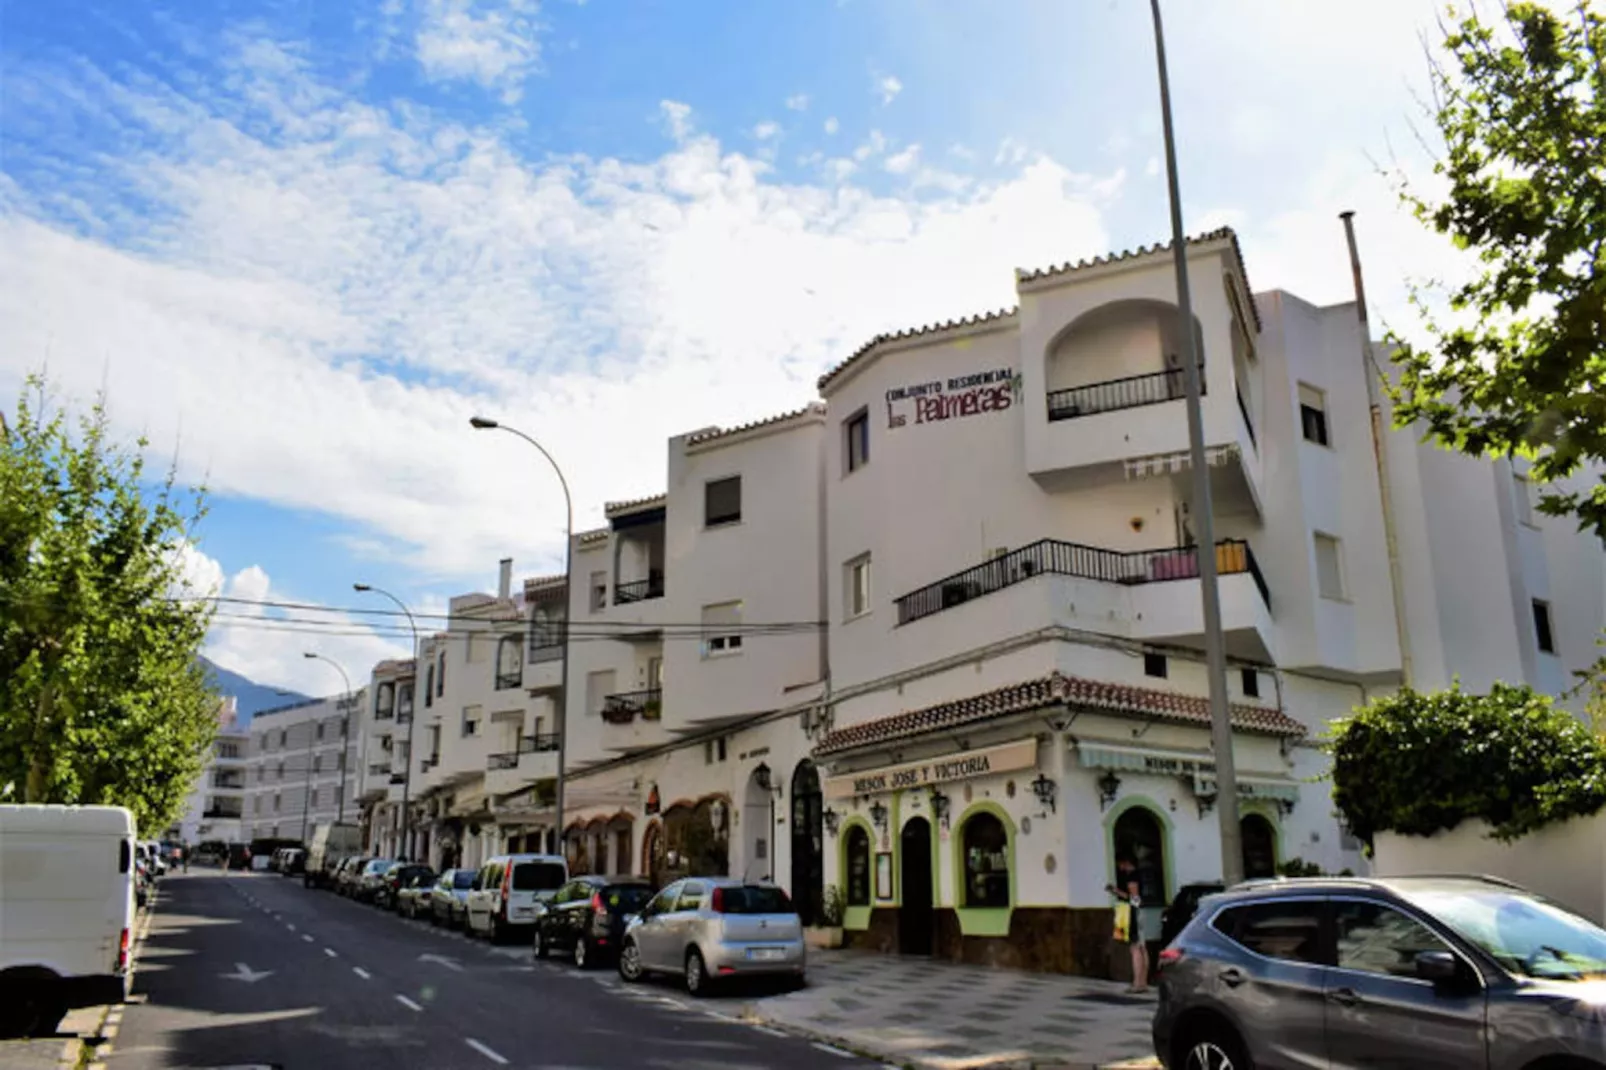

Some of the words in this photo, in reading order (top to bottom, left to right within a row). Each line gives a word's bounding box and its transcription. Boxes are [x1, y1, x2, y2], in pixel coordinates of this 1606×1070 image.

[886, 381, 942, 401] CONJUNTO
[948, 368, 1012, 390] RESIDENCIAL
[915, 382, 1012, 424] Palmeras
[934, 756, 990, 778] VICTORIA
